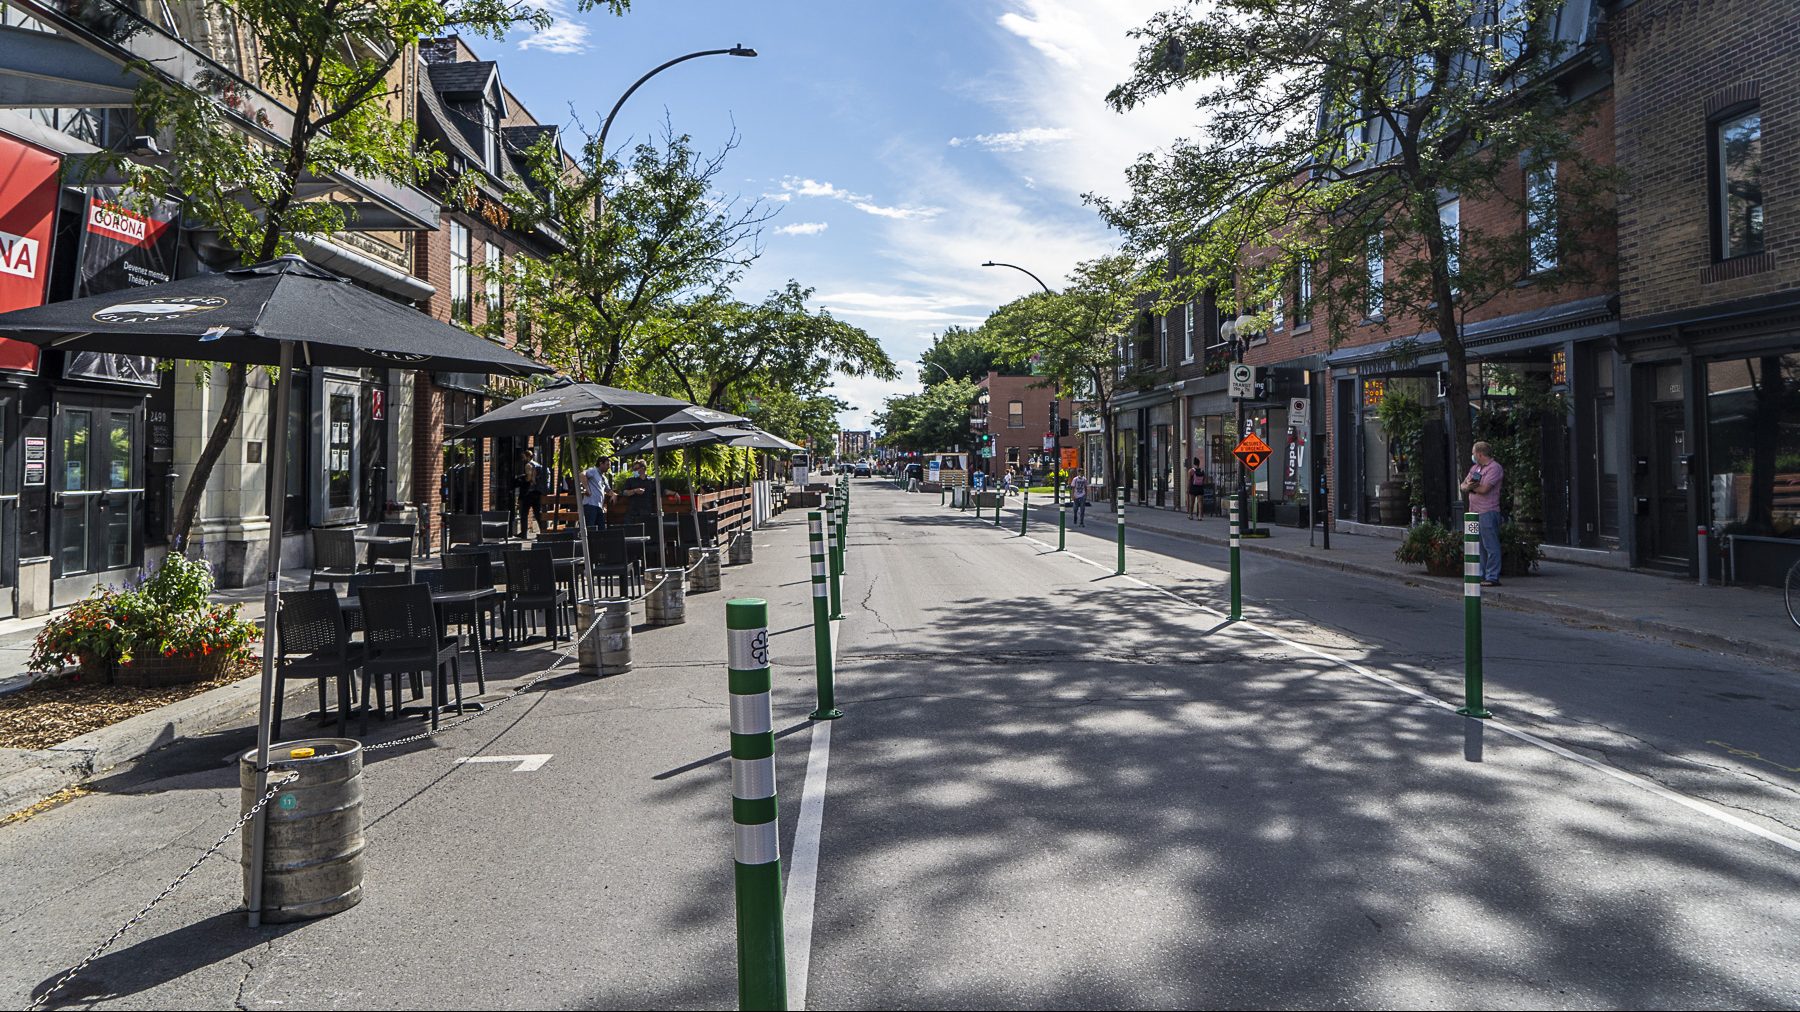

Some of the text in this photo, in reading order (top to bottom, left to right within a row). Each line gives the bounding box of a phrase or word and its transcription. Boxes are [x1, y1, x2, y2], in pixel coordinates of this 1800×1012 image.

[94, 210, 144, 238] CORONA
[123, 261, 169, 282] Devenez membre
